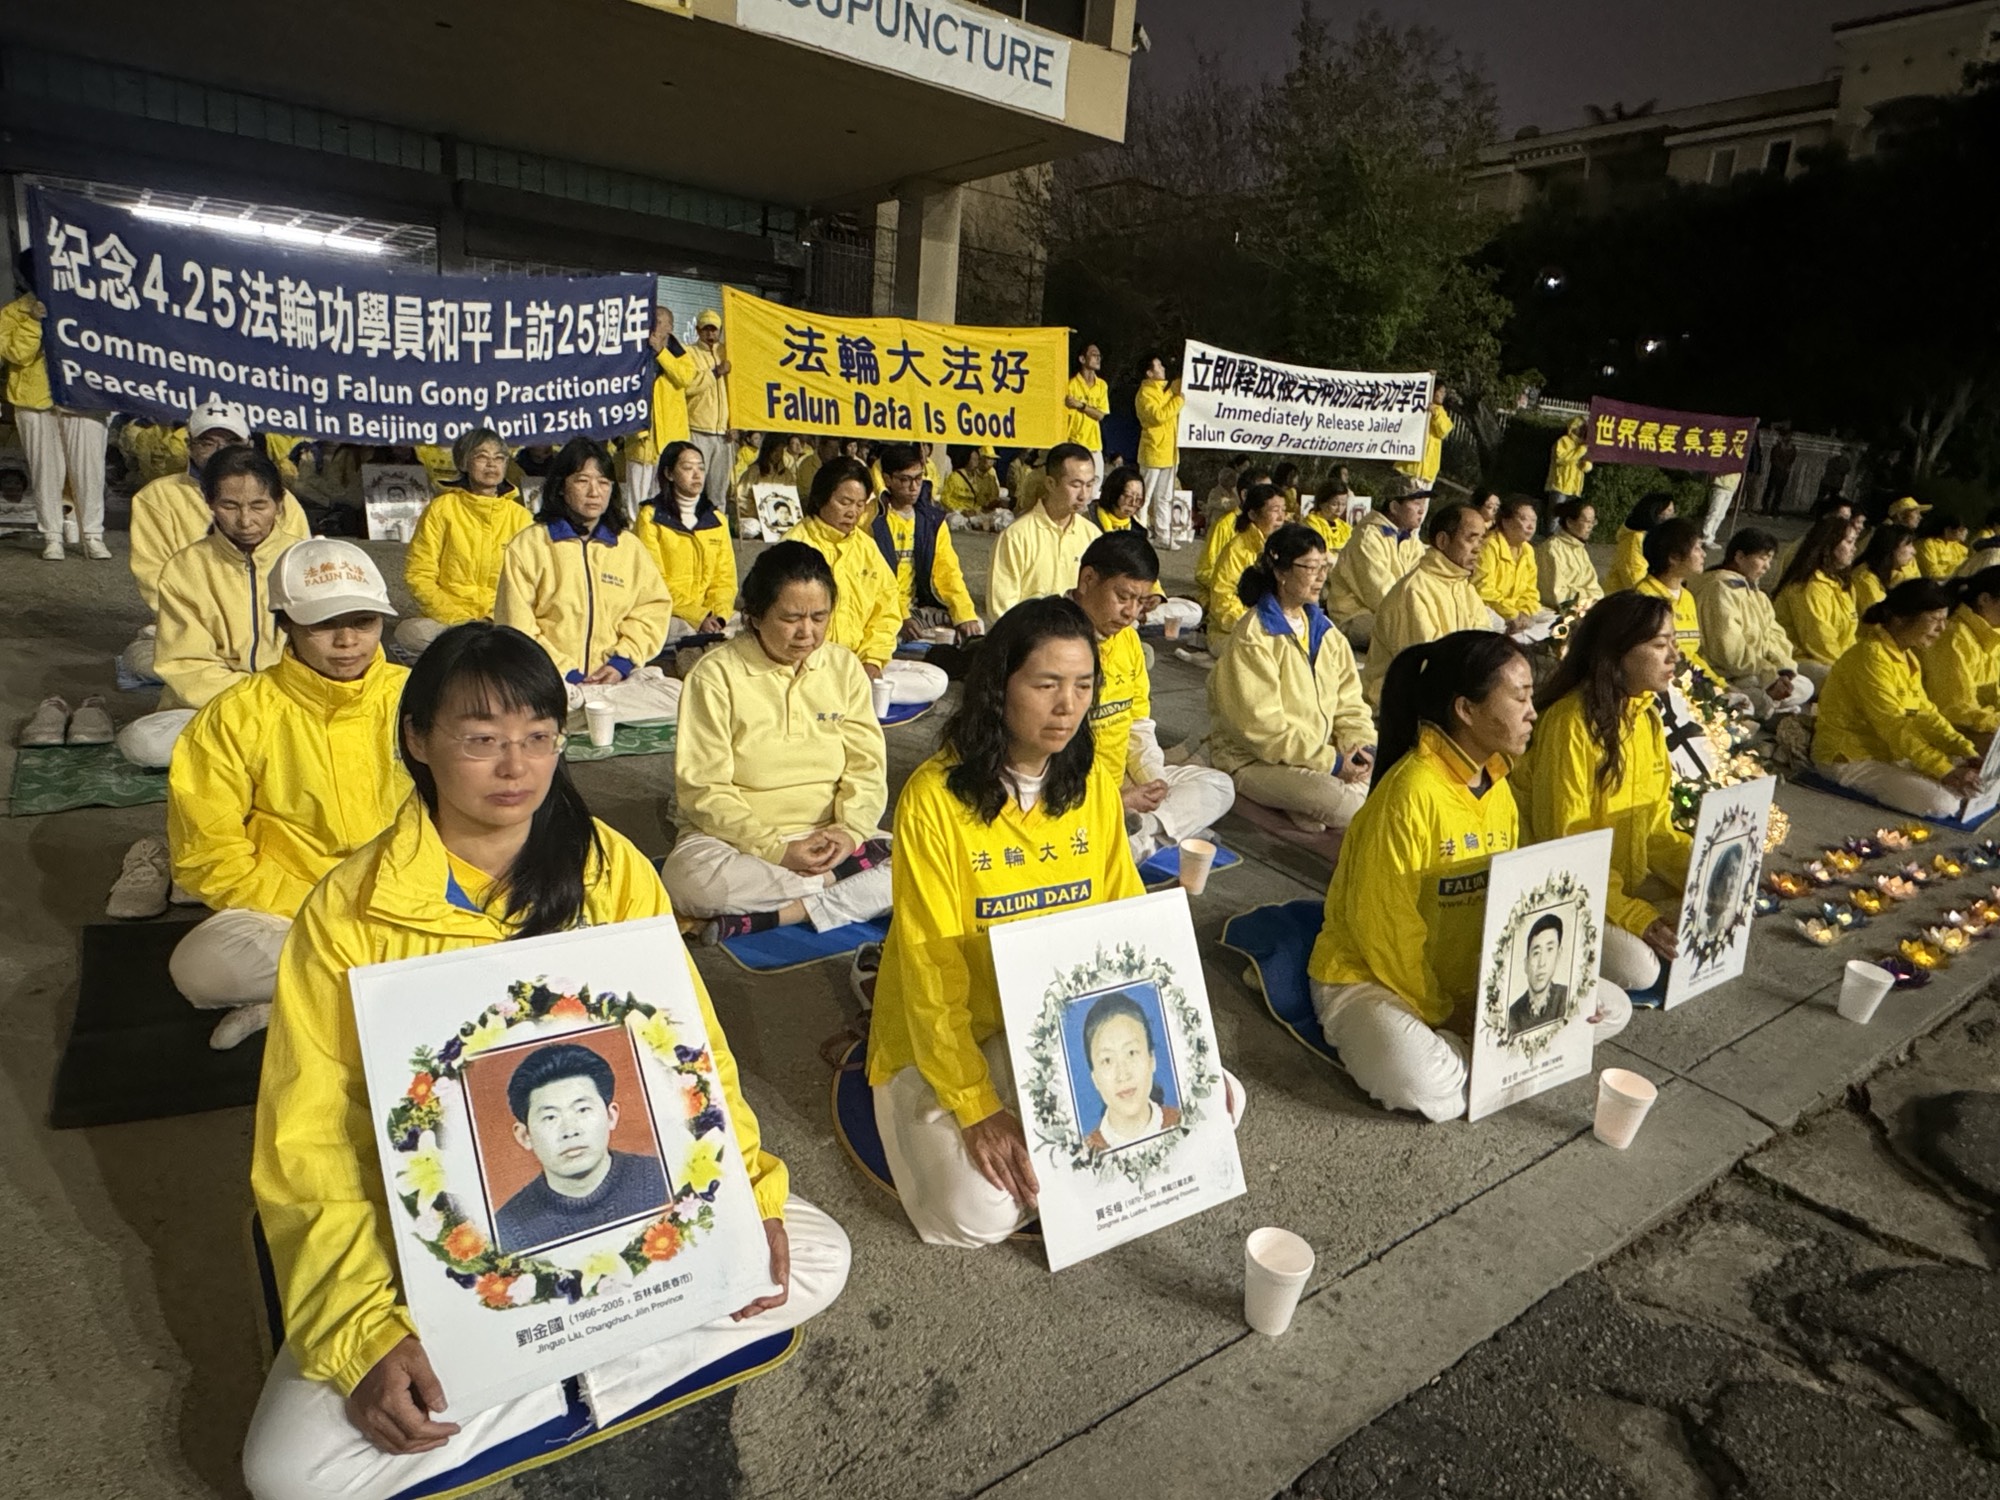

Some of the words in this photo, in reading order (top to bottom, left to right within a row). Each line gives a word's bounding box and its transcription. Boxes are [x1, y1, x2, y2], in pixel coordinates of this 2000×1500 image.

[775, 0, 1055, 90] PUNCTURE
[47, 216, 650, 364] 紀念4.25法輪功學員和平上訪25週年
[56, 318, 329, 404] Commemorating
[338, 374, 412, 405] Falun
[420, 381, 488, 411] Gong
[497, 366, 646, 405] Practitioners'
[779, 323, 1030, 395] 法輪大法好
[61, 359, 196, 411] Peaceful
[316, 409, 340, 434] in
[349, 413, 437, 444] Beijing
[444, 423, 473, 439] on
[483, 412, 536, 440] April
[543, 407, 593, 433] 25th
[598, 399, 648, 427] 1999
[766, 382, 840, 425] Falun
[924, 402, 947, 435] Is
[957, 402, 1016, 439] Good
[1214, 402, 1313, 432] Immediately
[1316, 412, 1364, 433] Release
[1368, 416, 1402, 433] Jailed
[1188, 424, 1225, 442] Falun
[1230, 428, 1274, 450] Gong
[1276, 433, 1364, 453] Practitioners
[1366, 440, 1379, 453] in
[1380, 440, 1415, 455] China
[972, 834, 1090, 873] 法輪大法
[981, 892, 1038, 917] FALUN
[1043, 883, 1090, 905] DAFA
[515, 1315, 565, 1348] 劉金國
[536, 1336, 567, 1354] Jinguo
[567, 1330, 584, 1343] Liu,
[585, 1313, 633, 1336] Changchun,
[634, 1306, 651, 1319] Jilin
[651, 1293, 685, 1312] Province
